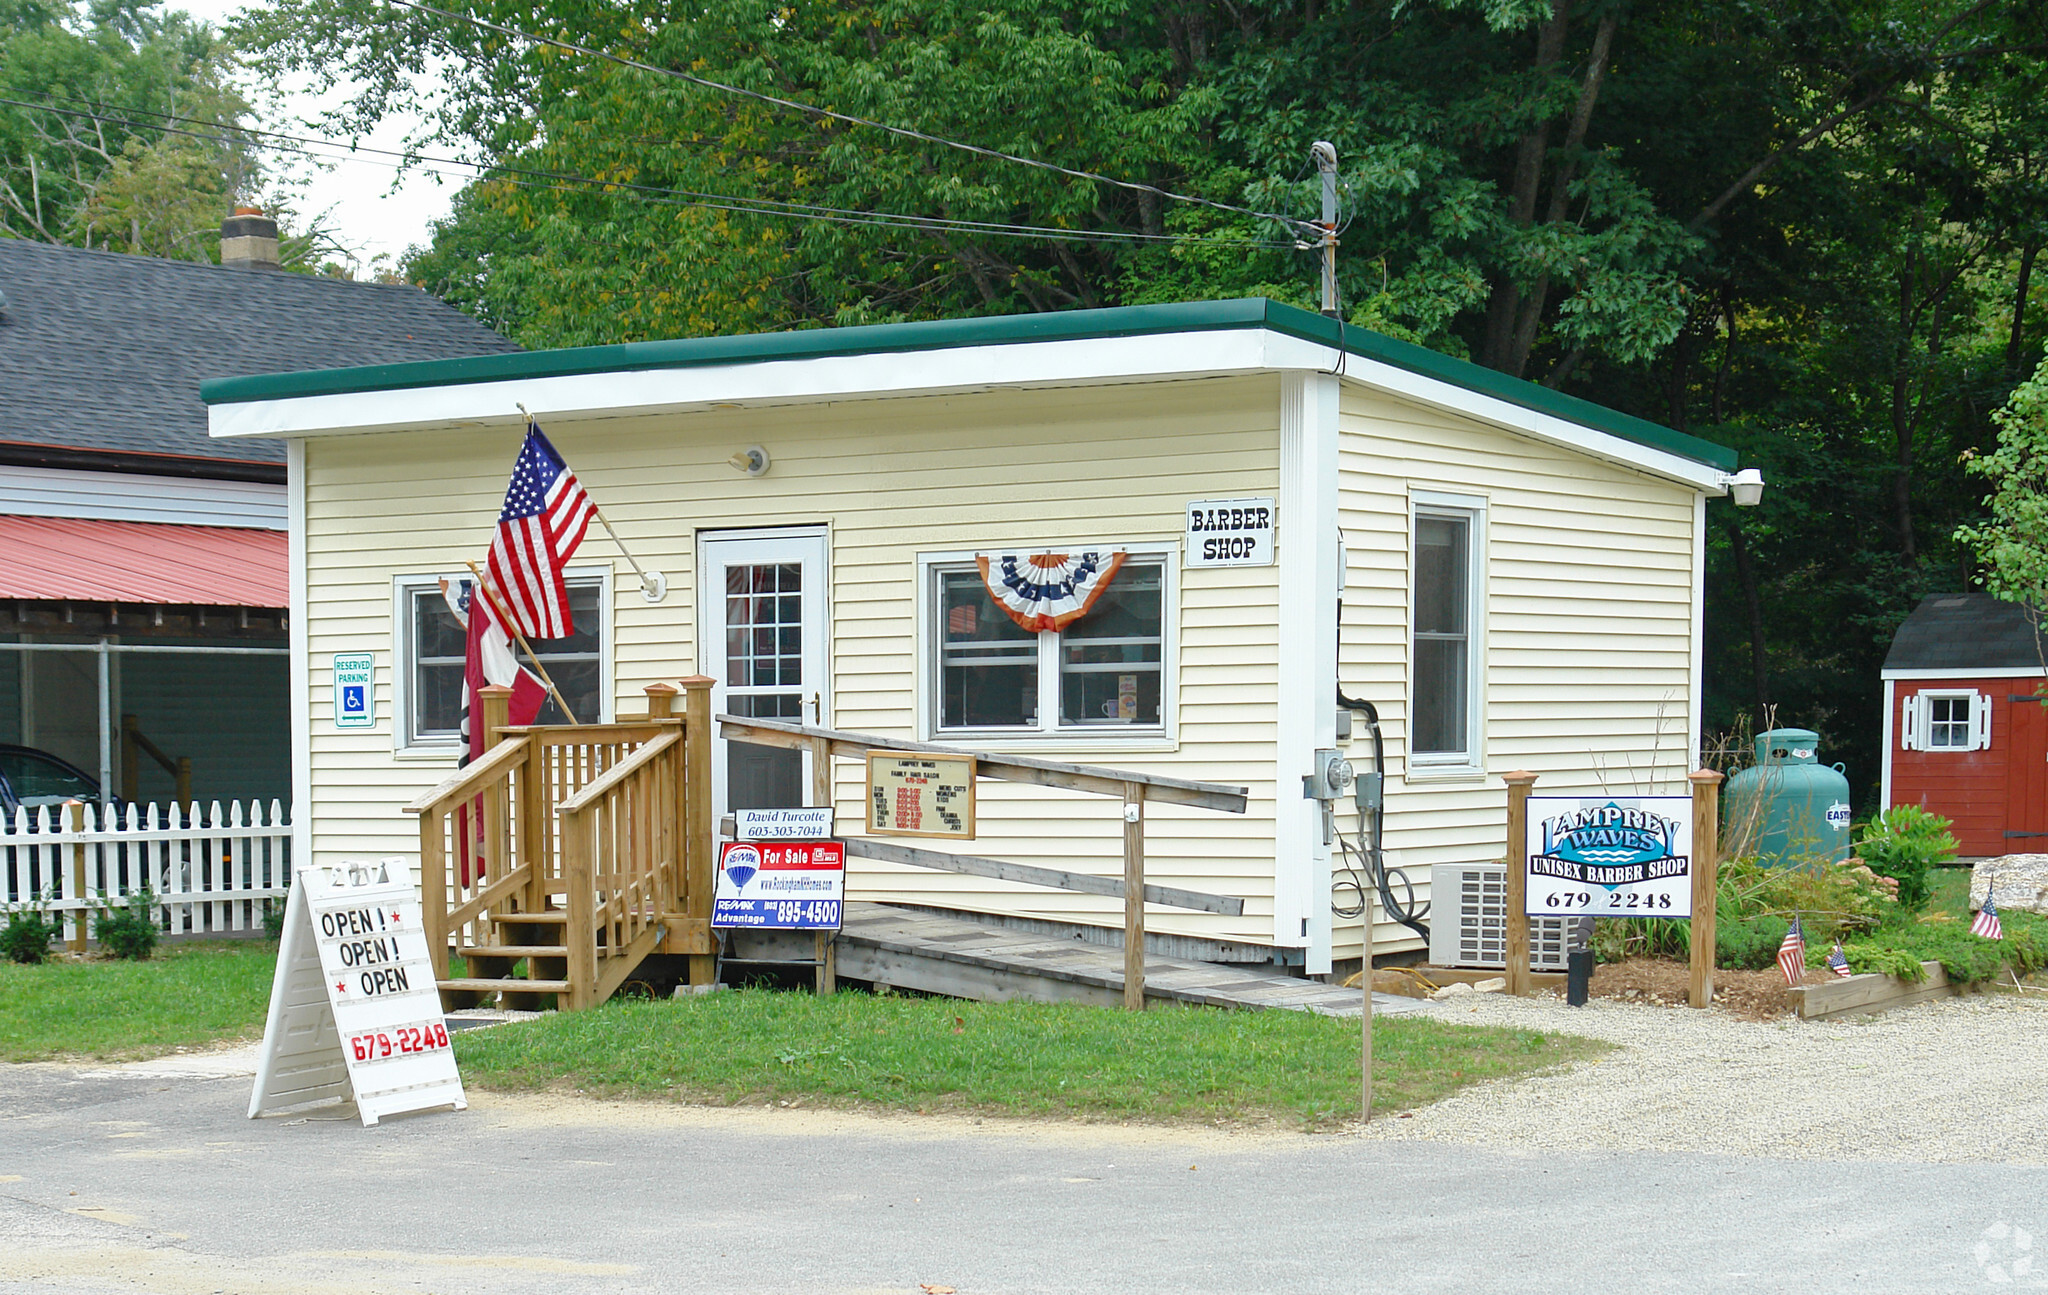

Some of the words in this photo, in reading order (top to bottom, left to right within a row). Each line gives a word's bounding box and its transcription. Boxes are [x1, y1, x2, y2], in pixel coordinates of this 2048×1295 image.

[1192, 507, 1270, 532] BARBER
[1203, 537, 1256, 560] SHOP
[336, 661, 370, 670] RESERVED
[338, 674, 368, 683] PARKING
[746, 811, 778, 822] David
[781, 811, 826, 822] Turcotte
[748, 826, 822, 836] 603-303-7044
[1542, 806, 1682, 856] LAMPREY
[1567, 829, 1656, 851] WAVES
[763, 848, 780, 864] For
[785, 848, 808, 864] Sale
[1532, 857, 1582, 880] UNISEX
[1586, 866, 1644, 884] BARBER
[1648, 858, 1687, 877] SHOP
[718, 900, 756, 910] RE/MAX
[1546, 892, 1591, 908] 679
[1609, 892, 1672, 909] 2248
[715, 912, 766, 925] Advantage
[778, 900, 838, 923] 895-4500
[360, 967, 409, 996] OPEN
[350, 1023, 449, 1061] 679-2248
